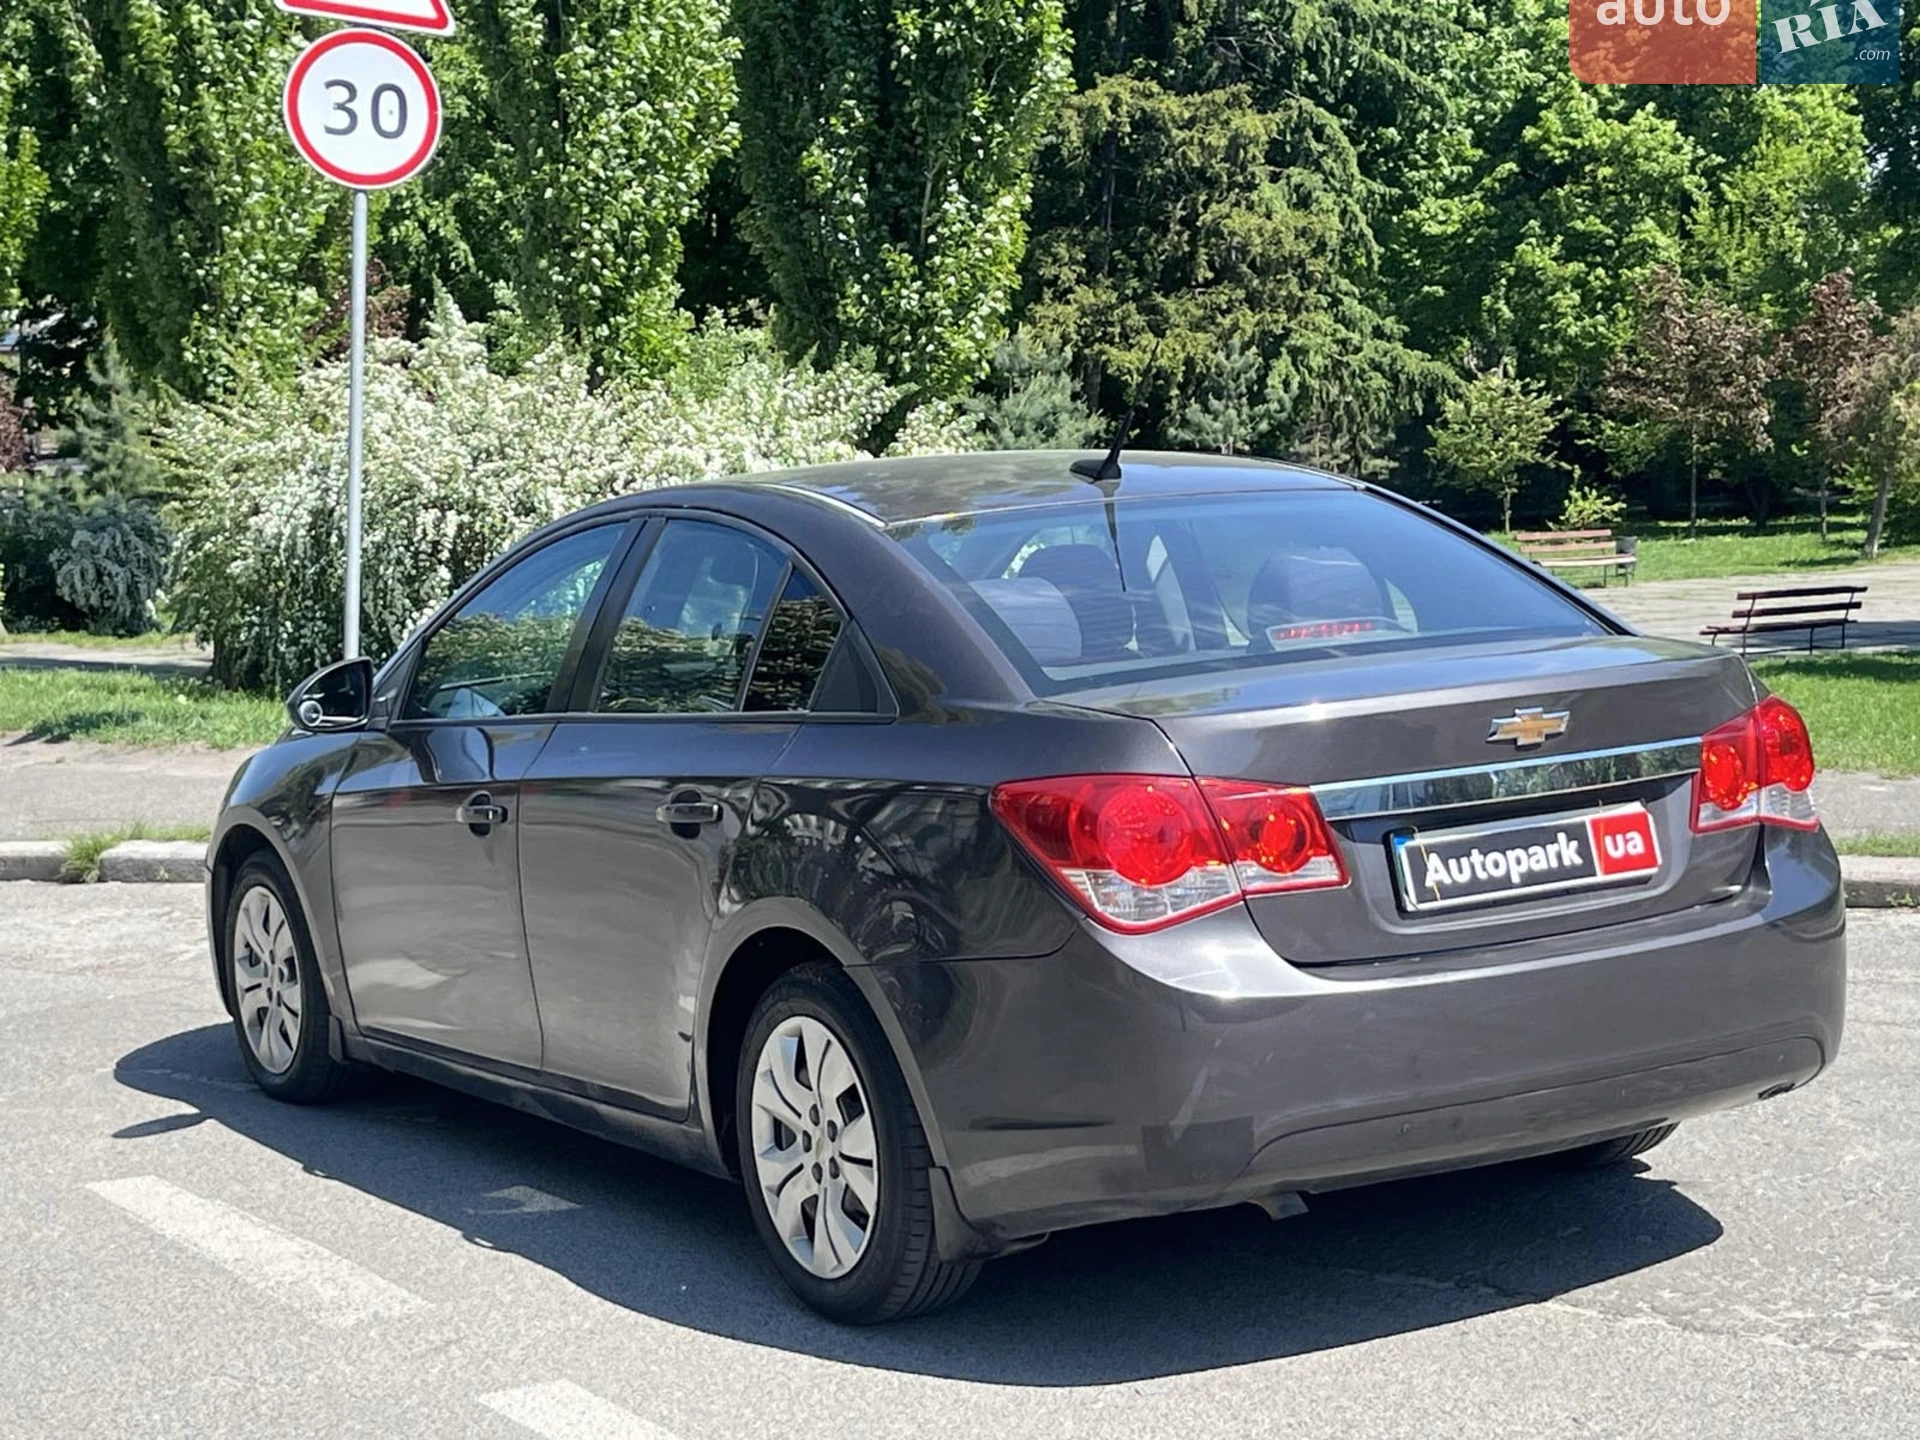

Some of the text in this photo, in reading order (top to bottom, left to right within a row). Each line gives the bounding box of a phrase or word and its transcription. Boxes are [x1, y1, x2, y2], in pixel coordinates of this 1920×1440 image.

[323, 78, 409, 140] 30
[1424, 830, 1647, 887] Autopark ua
